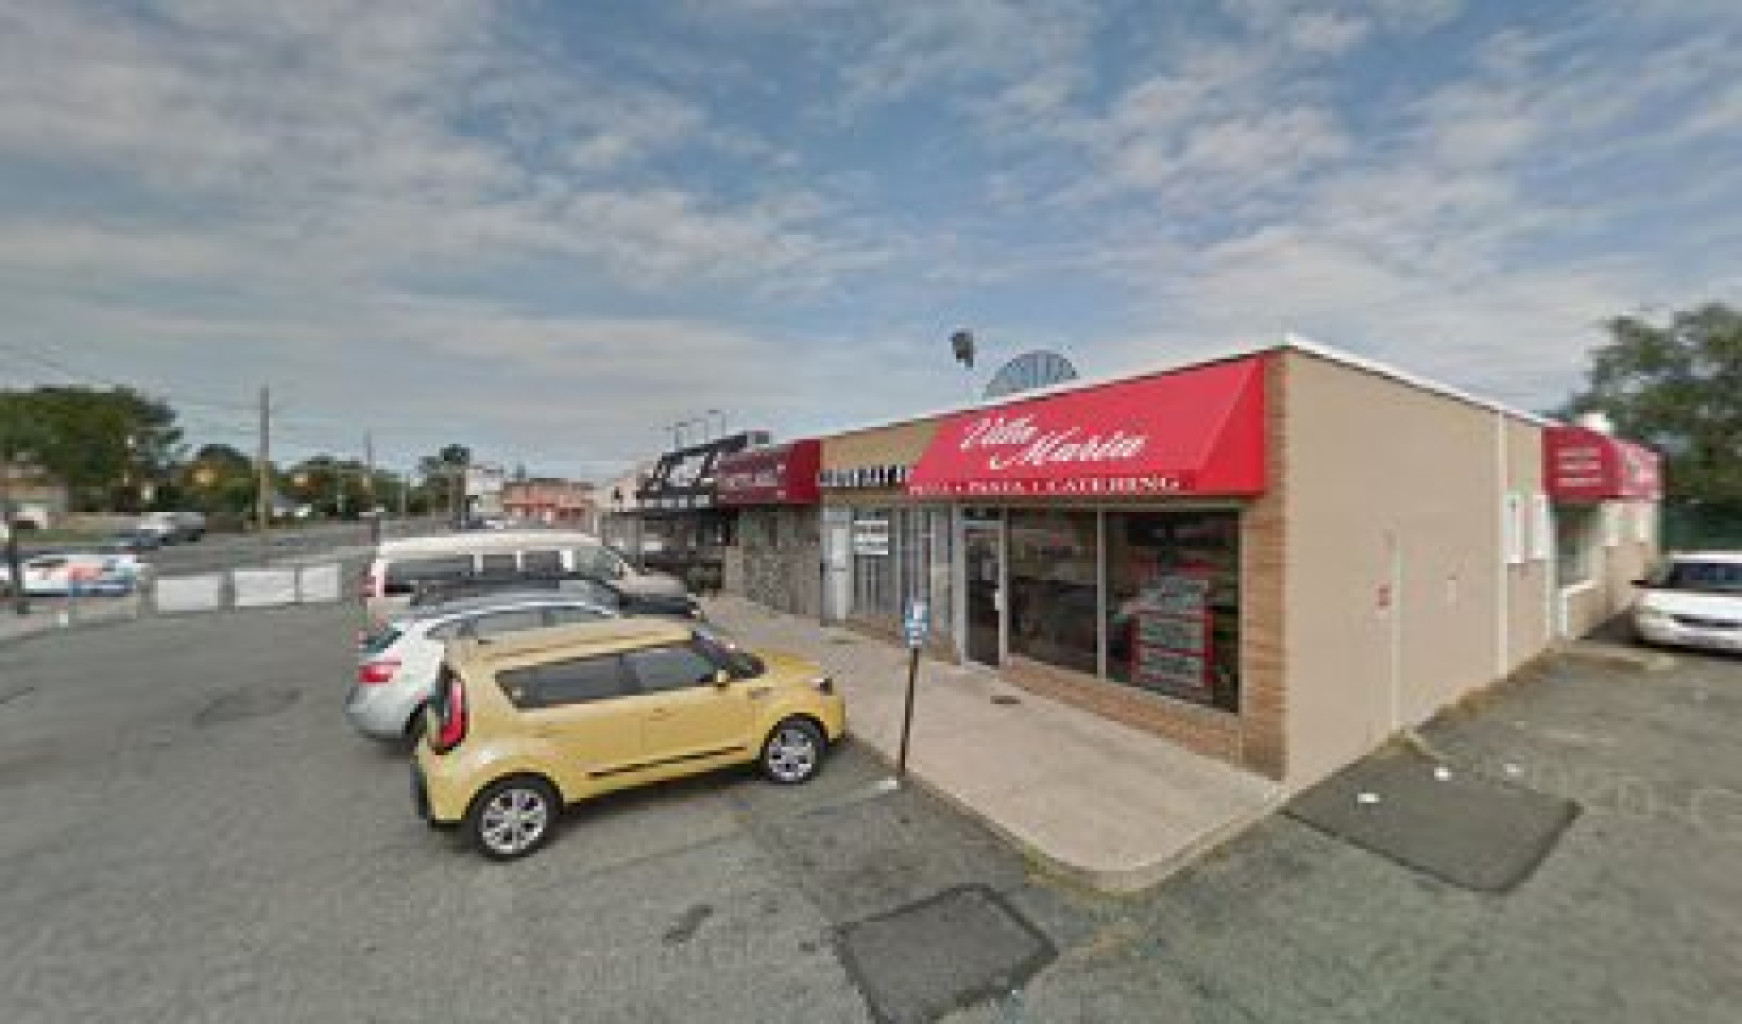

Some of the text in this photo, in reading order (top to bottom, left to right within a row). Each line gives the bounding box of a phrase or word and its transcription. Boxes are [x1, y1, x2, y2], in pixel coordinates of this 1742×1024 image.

[959, 415, 1038, 450] Villa
[990, 428, 1148, 470] Maria
[968, 480, 1026, 495] PASTA
[1049, 475, 1179, 493] CATERING
